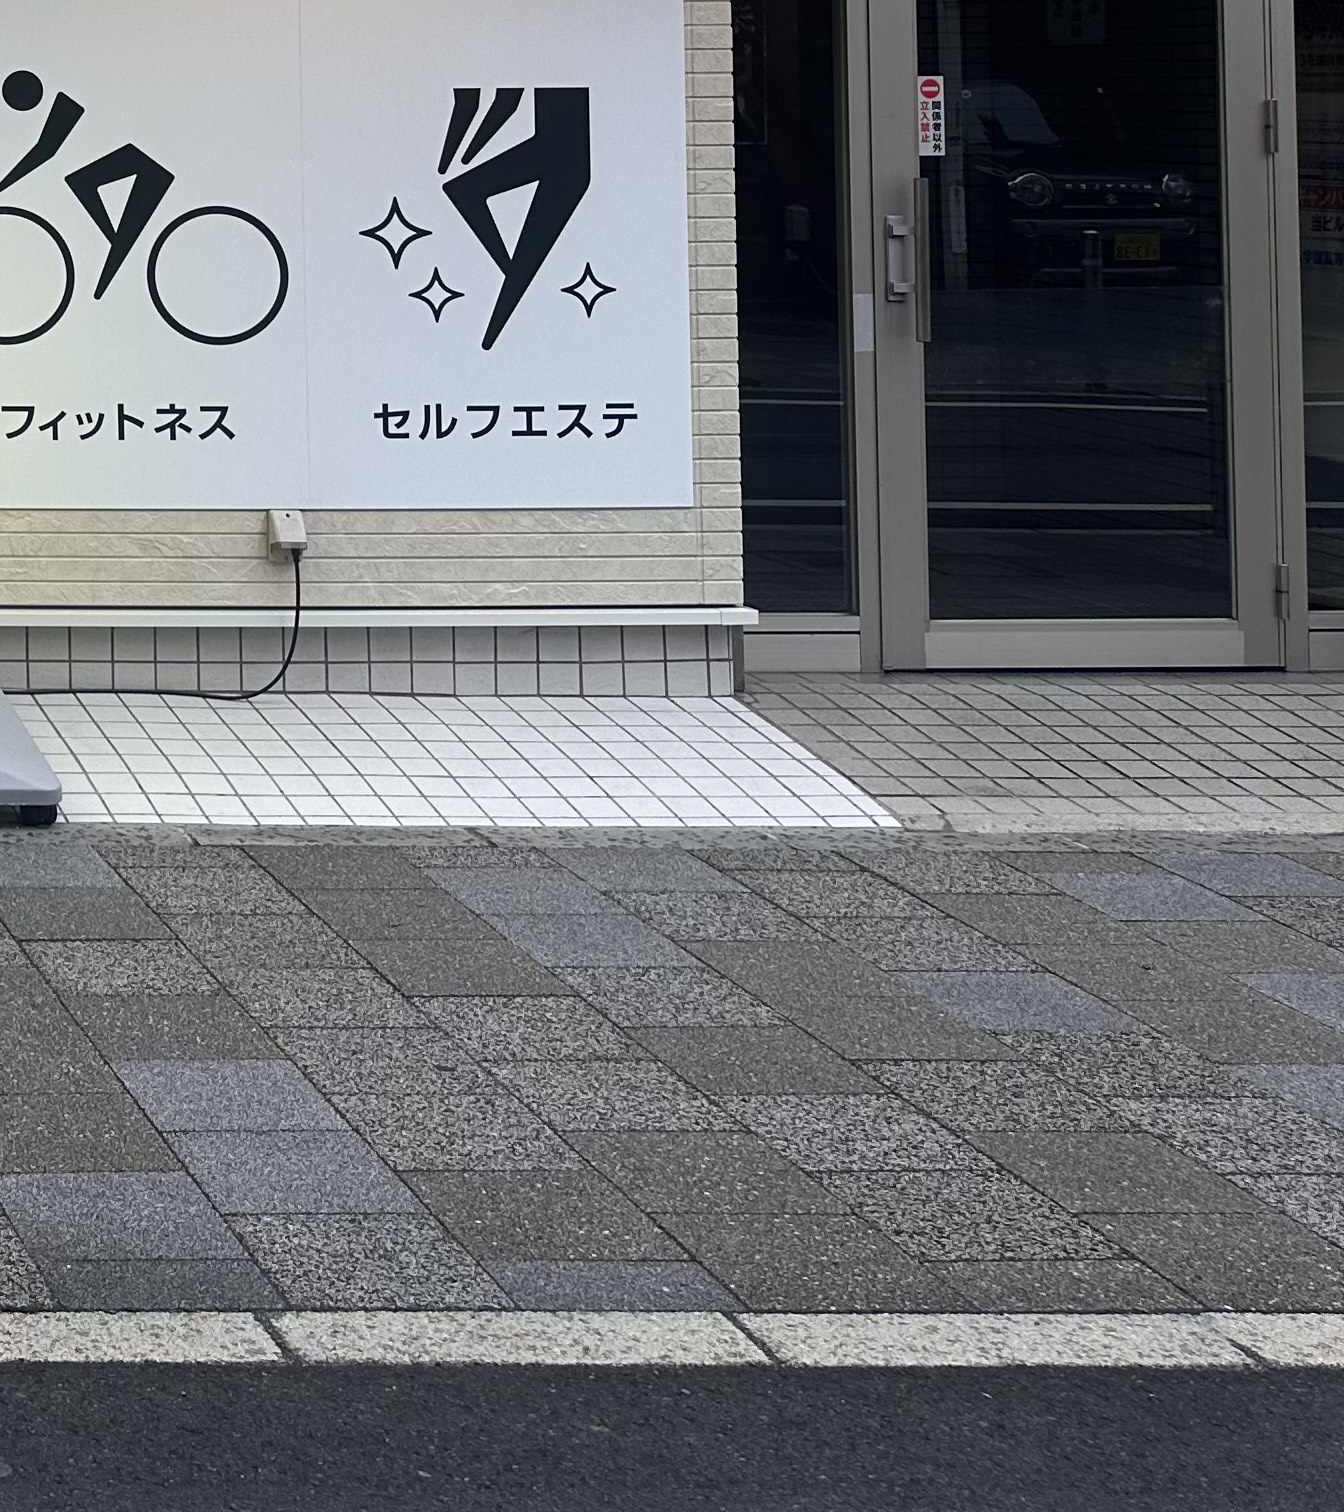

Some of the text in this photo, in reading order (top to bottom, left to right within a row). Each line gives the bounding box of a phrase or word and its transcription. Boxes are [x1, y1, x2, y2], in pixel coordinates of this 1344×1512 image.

[920, 101, 930, 143] 立入禁止
[931, 101, 942, 153] 関係者以外
[0, 403, 237, 442] フィットネス
[373, 402, 640, 441] セルフエステ
